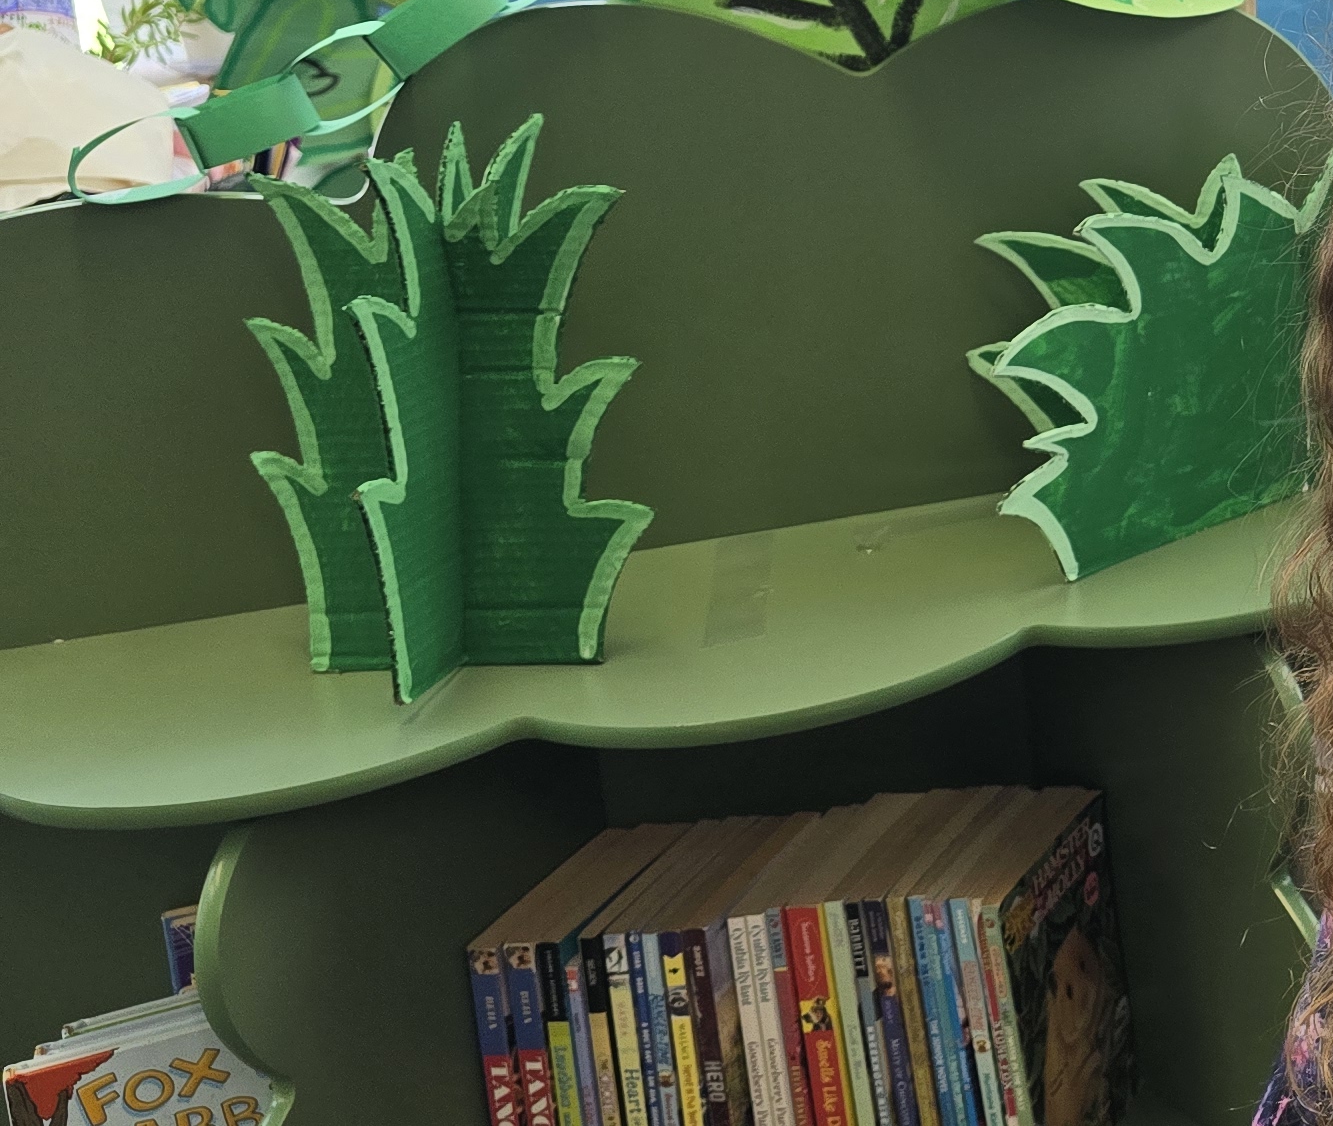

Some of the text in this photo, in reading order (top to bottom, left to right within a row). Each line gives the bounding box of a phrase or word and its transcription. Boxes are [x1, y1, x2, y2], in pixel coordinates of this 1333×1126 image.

[704, 1060, 726, 1103] HERO
[816, 1038, 834, 1083] Smells
[77, 1048, 231, 1126] FOX
